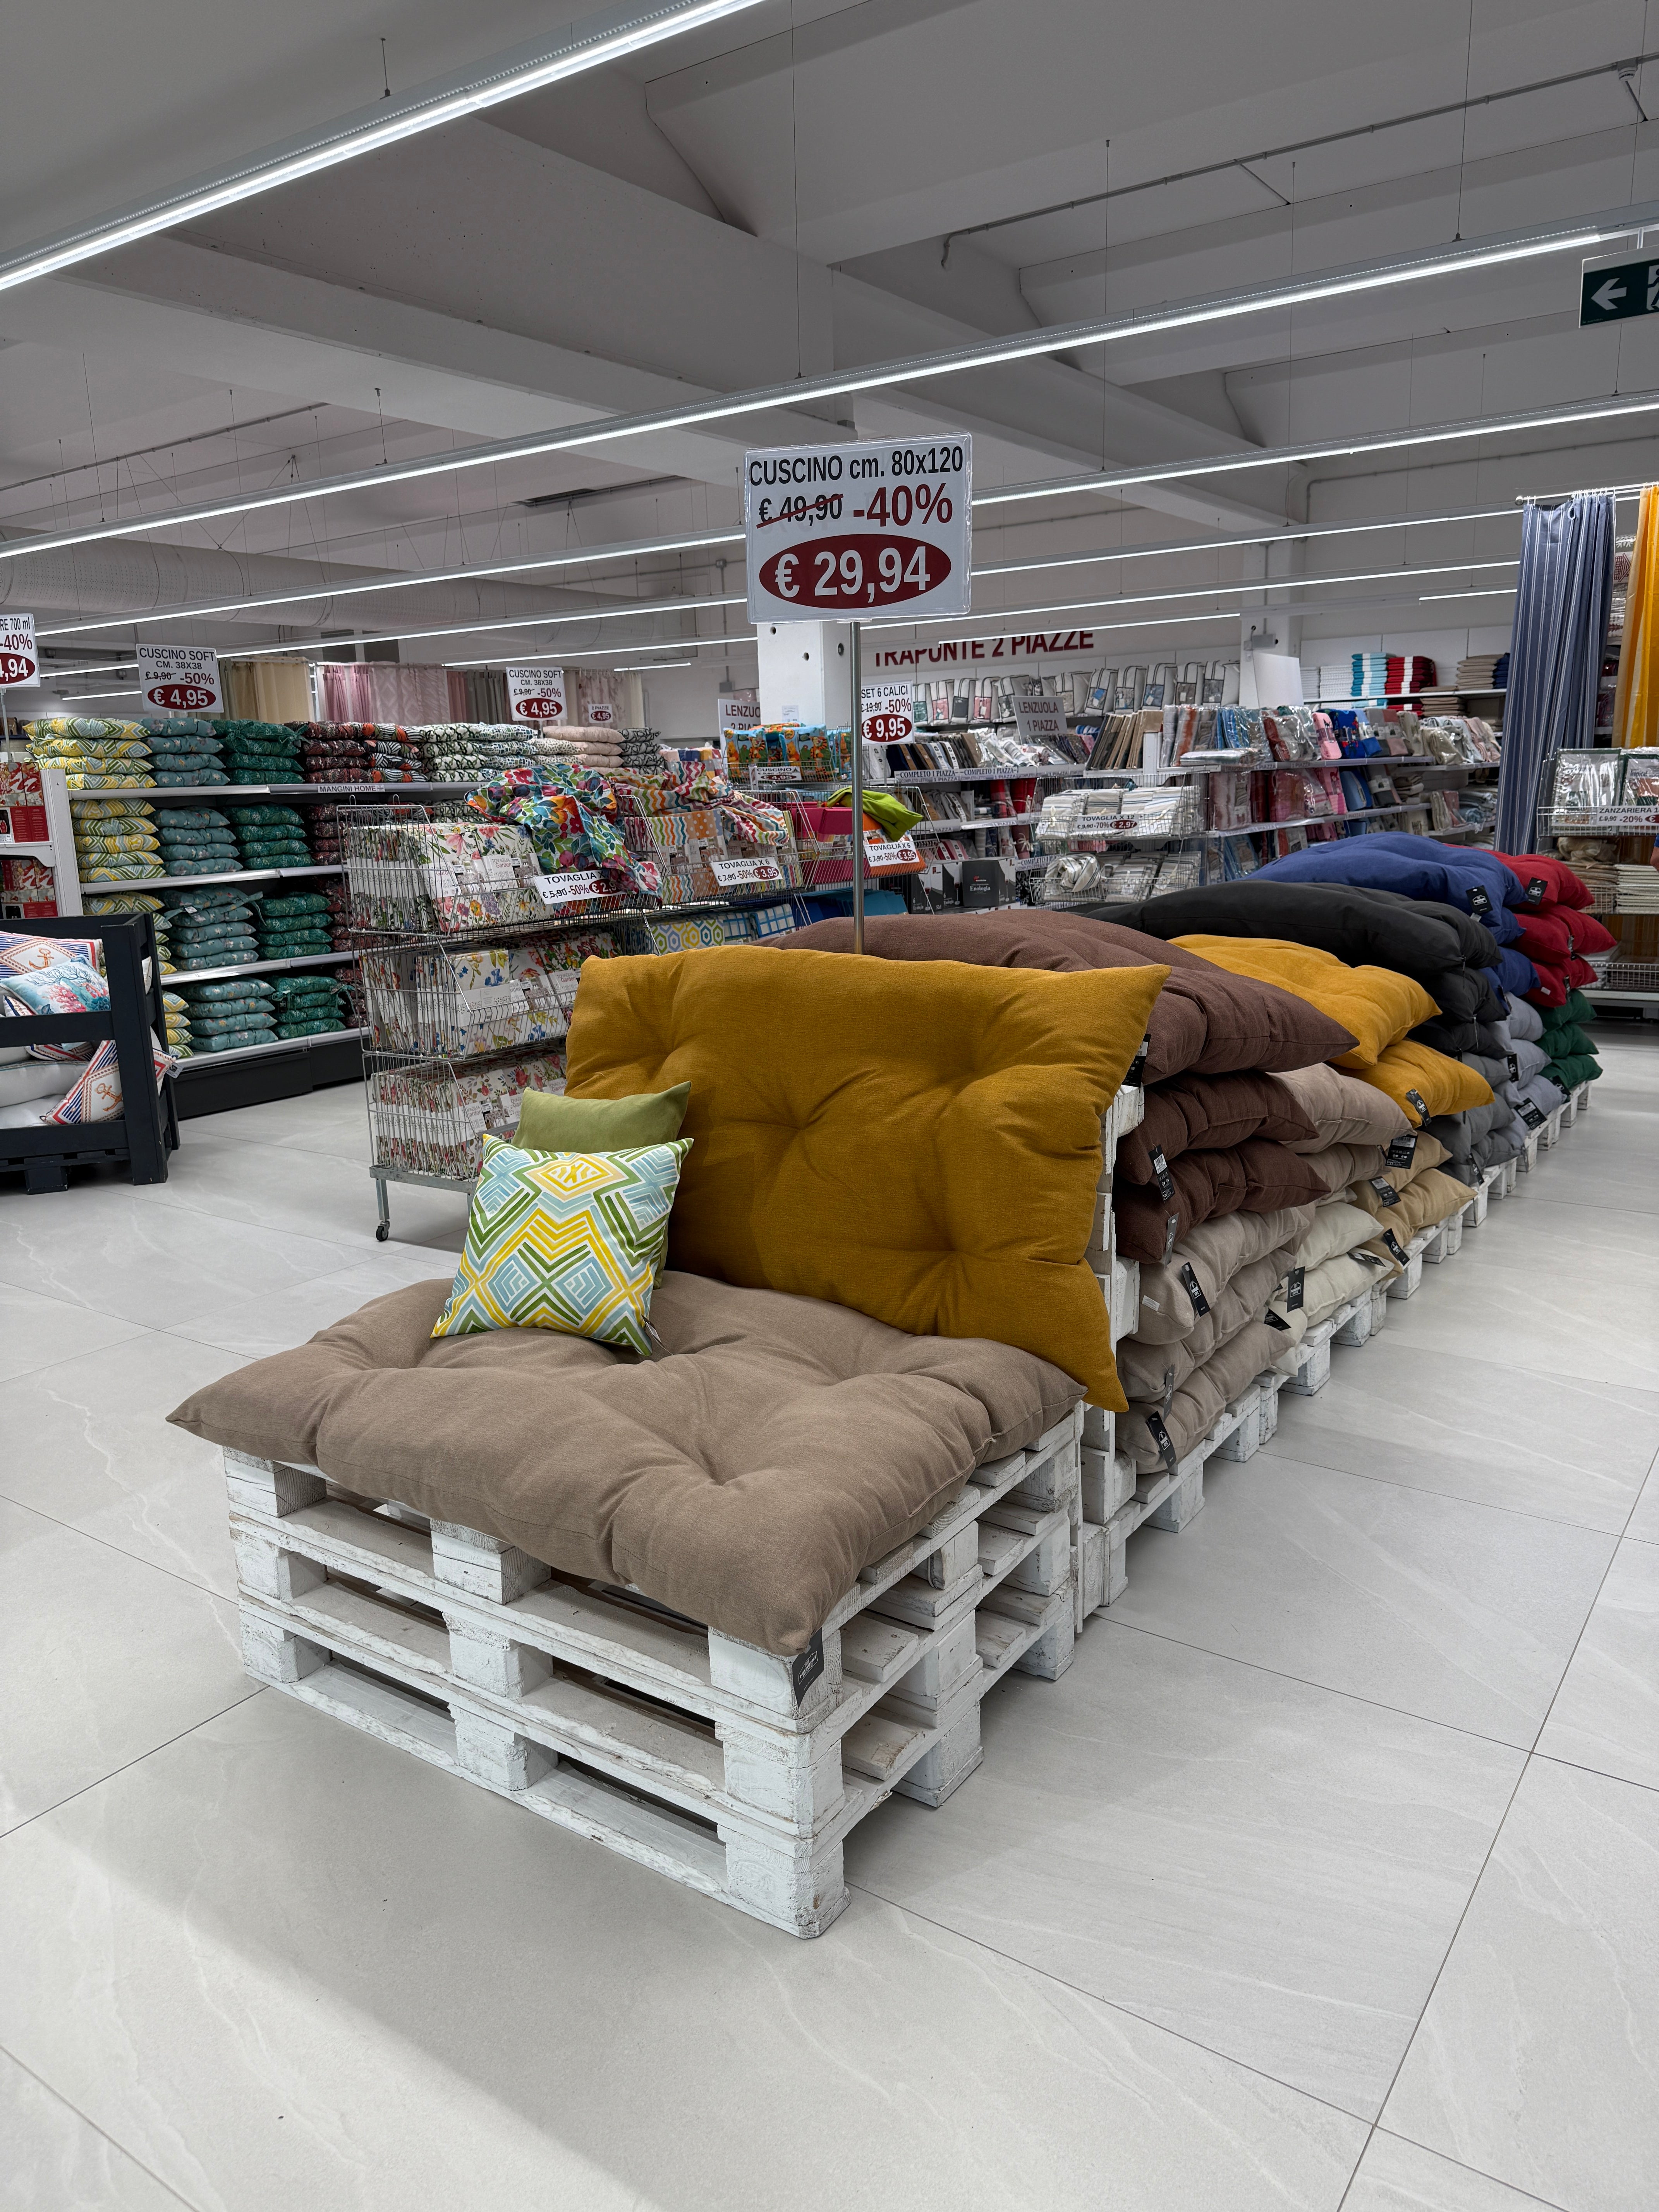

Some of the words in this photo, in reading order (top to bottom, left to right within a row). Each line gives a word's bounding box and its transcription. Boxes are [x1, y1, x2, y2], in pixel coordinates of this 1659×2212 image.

[750, 455, 843, 486] CUSCINO
[850, 456, 884, 479] cm.
[892, 446, 963, 476] 80x120
[759, 498, 772, 523] €
[780, 494, 843, 526] 49,90
[853, 483, 953, 527] -40%
[775, 553, 800, 598] €
[814, 546, 930, 603] 29,94
[10, 618, 21, 630] 700
[22, 617, 30, 630] ml
[0, 634, 33, 651] -40%
[992, 638, 1004, 657] 2
[1012, 630, 1094, 655] PIAZZE
[139, 648, 186, 659] CUSCINO
[189, 651, 214, 661] SOFT
[153, 672, 172, 681] 9,90
[180, 672, 214, 685] -50%
[538, 688, 561, 697] -50%
[862, 689, 875, 698] SET
[878, 688, 881, 697] 6
[883, 685, 908, 697] CALICI
[153, 689, 165, 705] €
[170, 689, 208, 708] 4,95
[520, 702, 528, 715] €
[531, 702, 557, 718] 4,95
[725, 705, 761, 717] LENZUO
[866, 702, 881, 713] 19,90
[885, 698, 911, 713] -50%
[1018, 702, 1059, 713] LENZUOLA
[863, 720, 872, 738] €
[876, 718, 905, 741] 9,95
[1027, 720, 1031, 731] 1
[1032, 720, 1059, 731] PIAZZA
[884, 852, 897, 860] -50%
[904, 851, 915, 860] 3,95
[719, 860, 757, 869] TOVAGLIA
[544, 872, 597, 884] TOVAGLIA
[723, 873, 736, 882] 7,90
[737, 870, 754, 879] -50%
[754, 870, 760, 878] €
[761, 868, 778, 879] 3,95
[550, 888, 567, 899] 5,90
[568, 884, 589, 895] -50%
[592, 883, 599, 893] €
[600, 881, 617, 893] 2,9
